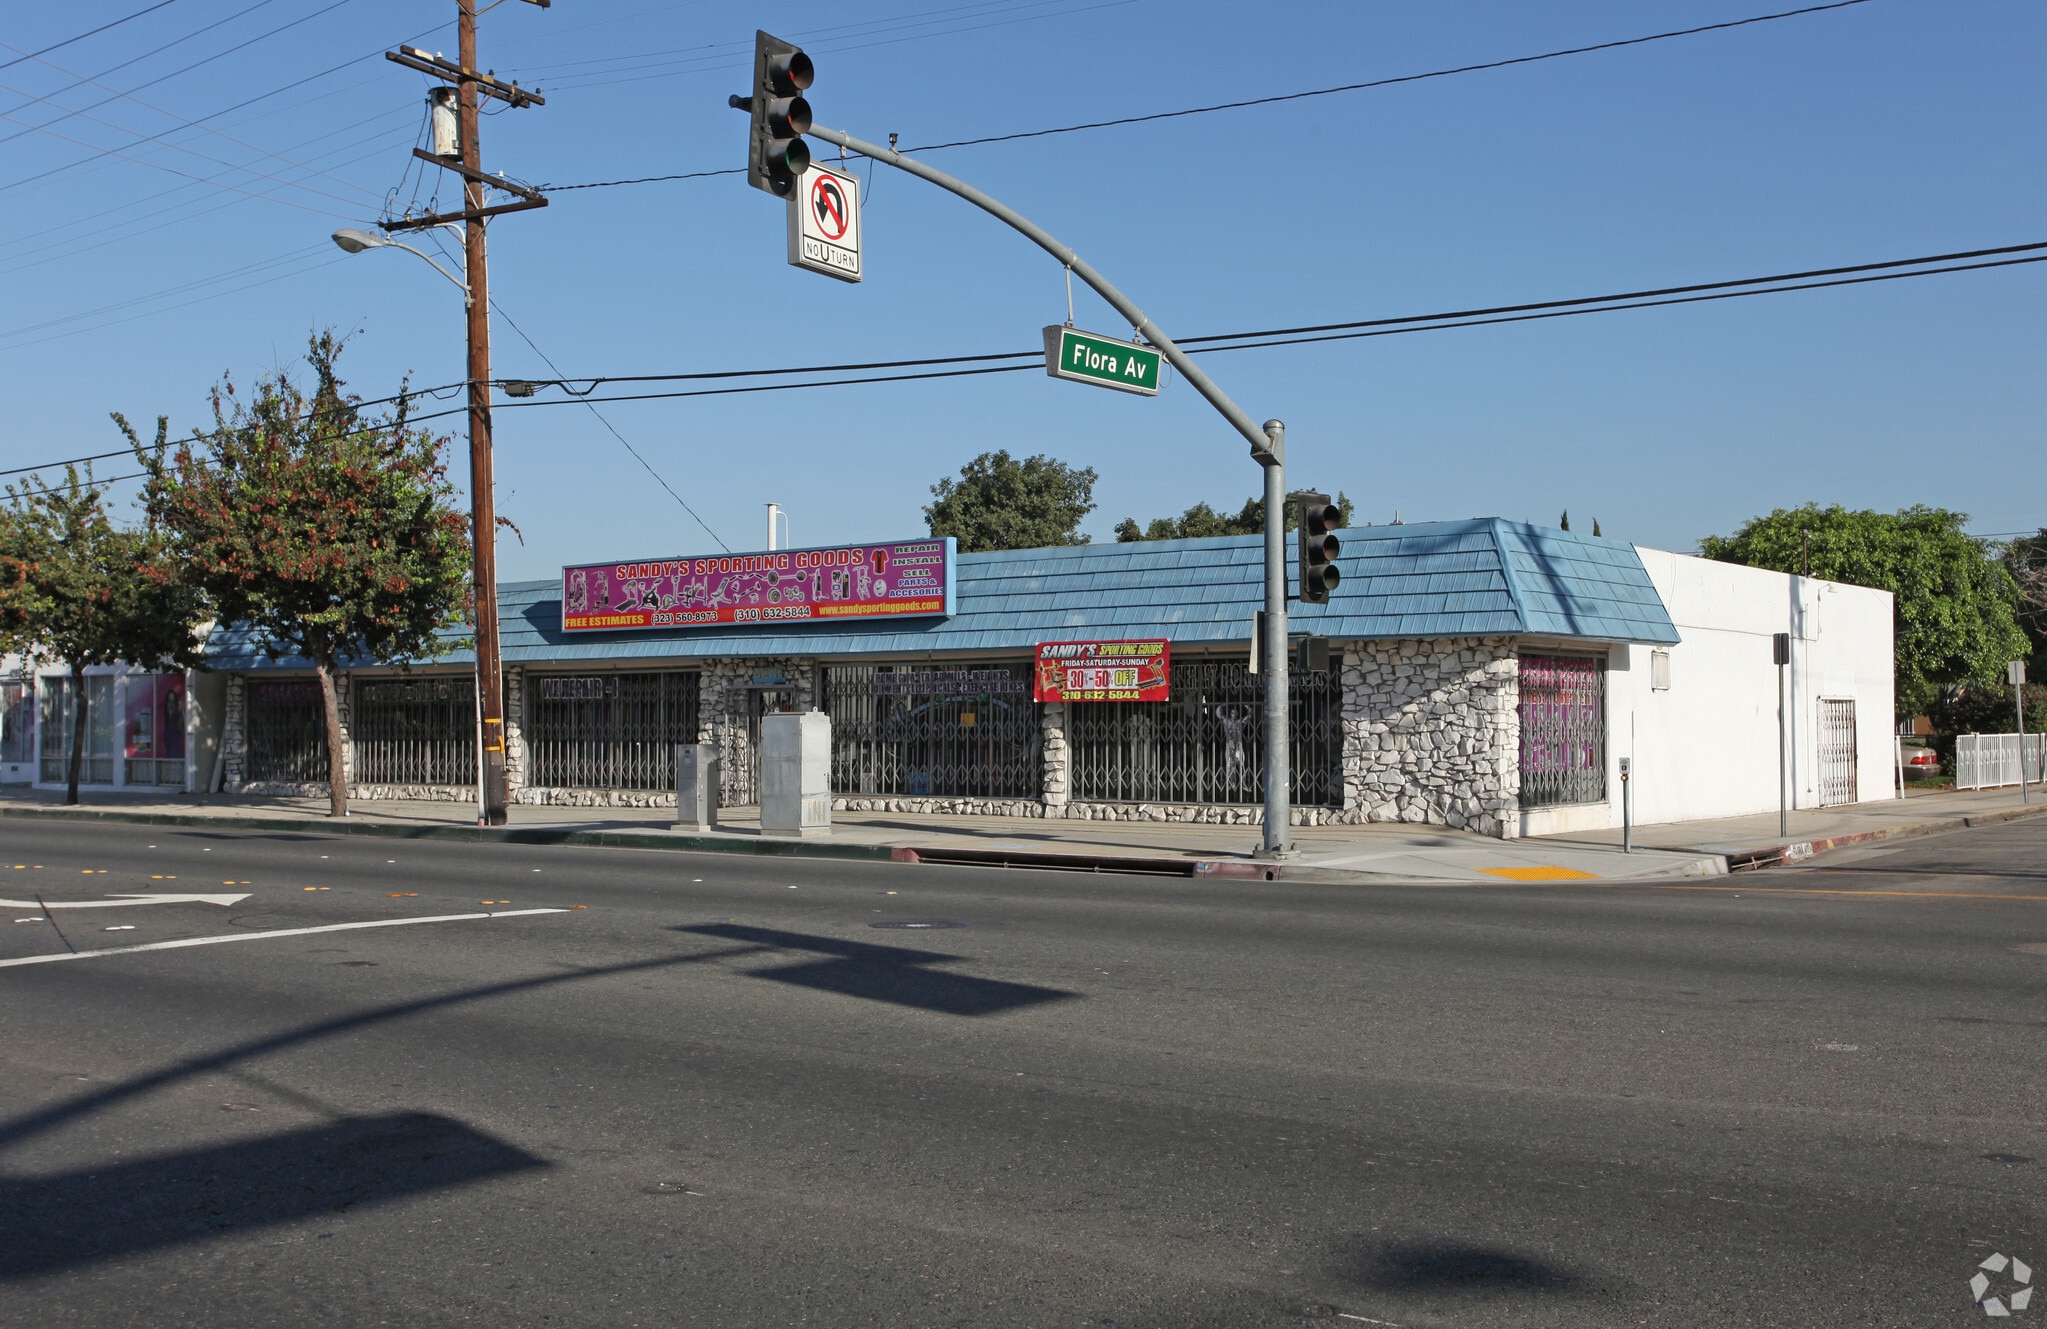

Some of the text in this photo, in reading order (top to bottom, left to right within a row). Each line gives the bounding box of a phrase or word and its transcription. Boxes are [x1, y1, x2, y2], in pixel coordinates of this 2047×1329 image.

[806, 242, 855, 268] NO U TURN
[1073, 344, 1146, 379] Flora Av
[895, 544, 939, 554] REPAIR
[616, 548, 864, 580] SANDY'S SPORTING GOODS
[893, 556, 942, 566] INSTALL
[903, 569, 931, 577] SELL
[898, 578, 928, 587] PARTS
[889, 586, 944, 598] ACCESORIES
[565, 600, 940, 628] FREE ESTIMATES (323) 560-8973 (310) 632-5844 www.sandysportinggoods.com
[1040, 644, 1164, 658] SANDY'S SPORTING GOODS
[920, 670, 967, 682] TRADMILLS
[1114, 670, 1136, 686] OFF
[1062, 690, 1140, 700] 310-632-5844
